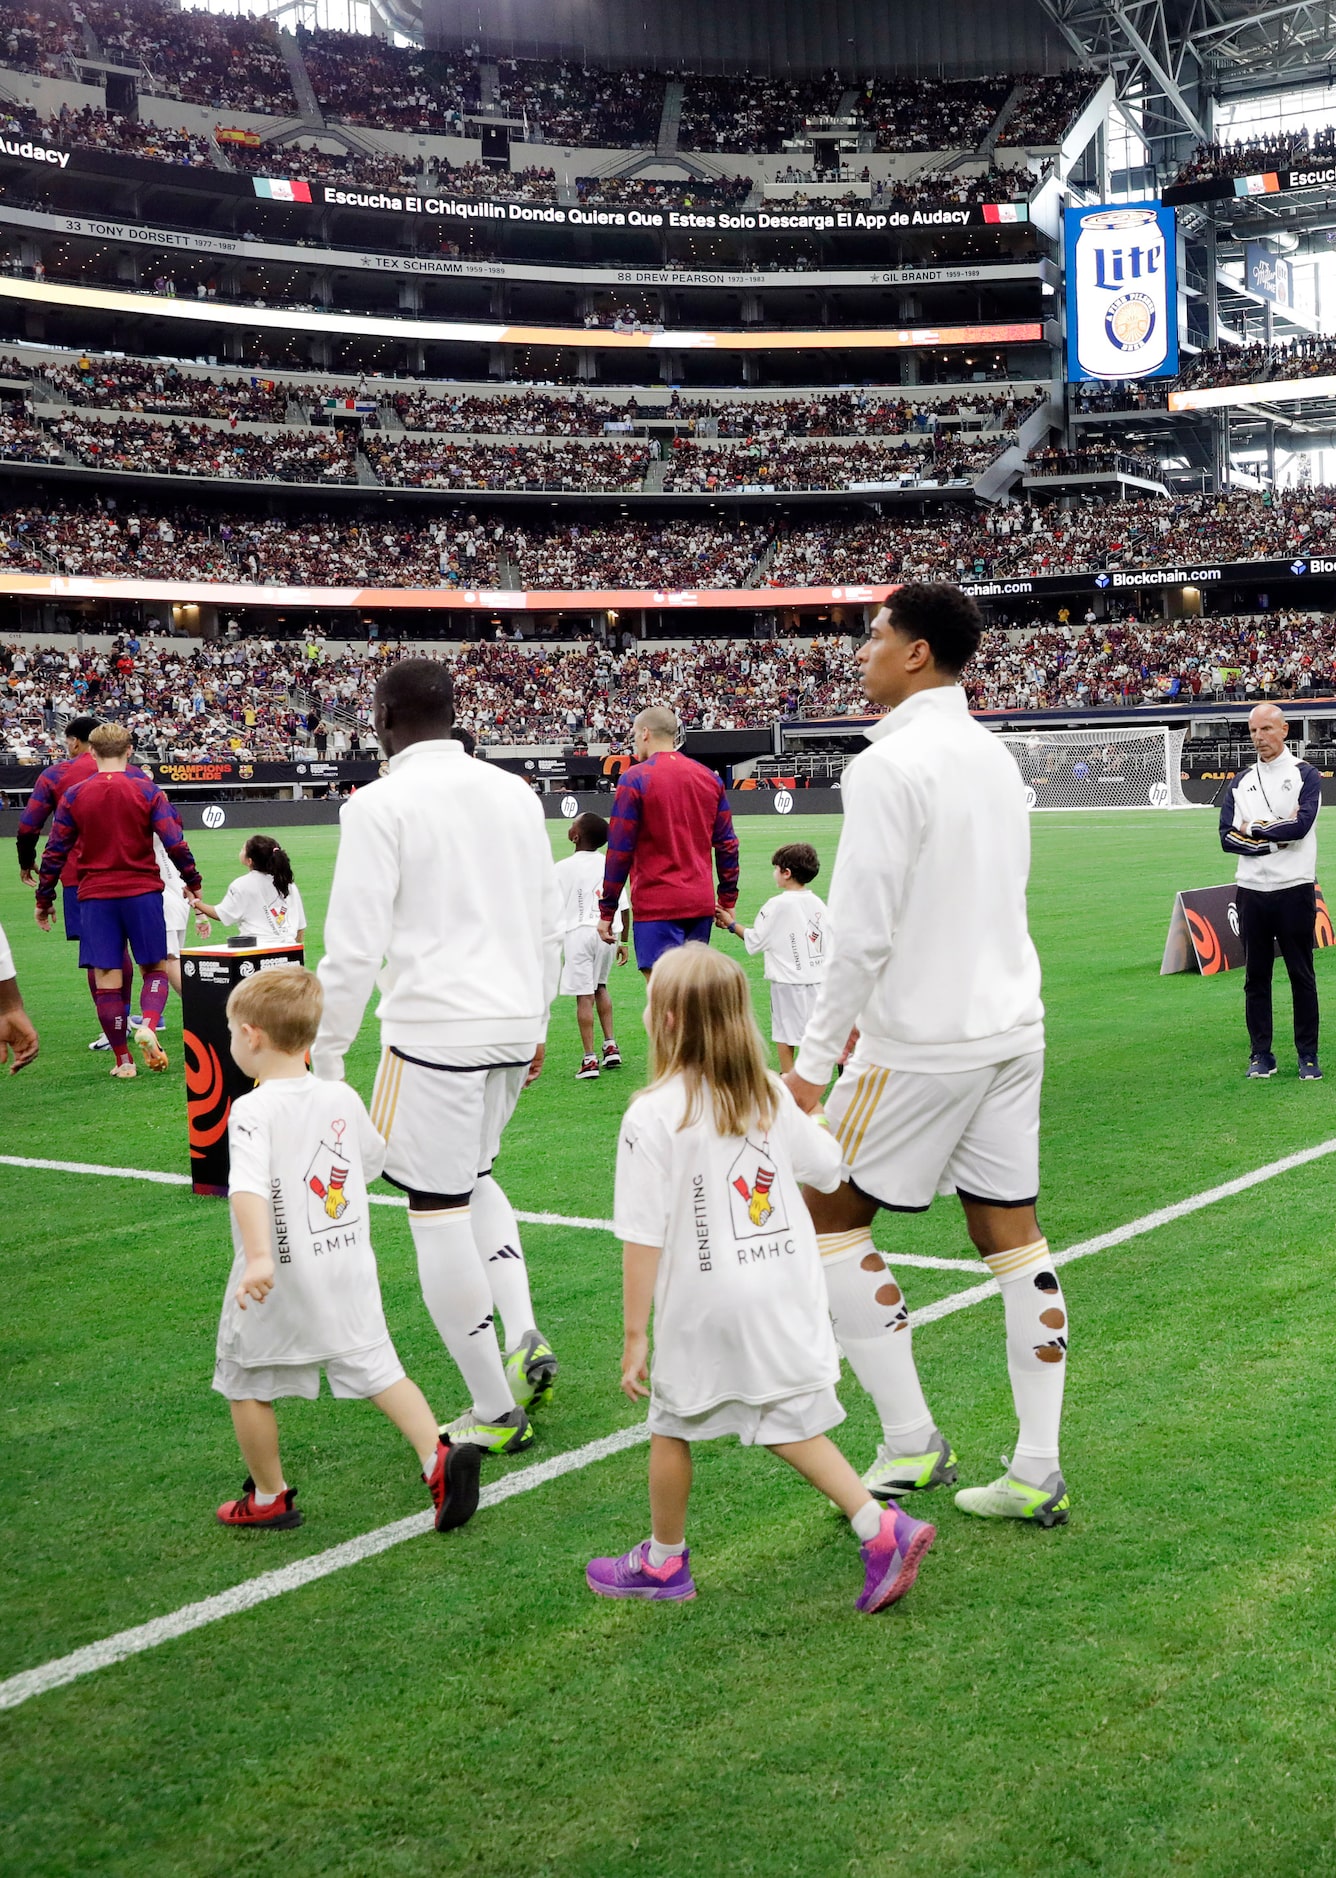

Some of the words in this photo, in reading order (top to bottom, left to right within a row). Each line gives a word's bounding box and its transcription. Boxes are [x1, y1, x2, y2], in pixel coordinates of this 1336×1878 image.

[0, 136, 70, 168] Audacy
[324, 188, 402, 211] Escucha
[406, 197, 422, 213] El
[425, 200, 505, 220] Chiquilin
[509, 204, 566, 224] Donde
[568, 209, 625, 227] Quiera
[628, 211, 663, 227] Que
[669, 213, 716, 228] Estes
[719, 213, 756, 229] Solo
[759, 213, 834, 230] Descarga
[838, 212, 852, 227] El
[855, 212, 889, 230] App
[891, 211, 909, 227] de
[912, 209, 971, 226] Audacy
[65, 220, 82, 231] 33
[89, 223, 123, 237] TONY
[129, 228, 191, 247] DORSETT
[375, 257, 399, 269] TEX
[403, 260, 463, 273] SCHRAMM
[882, 272, 899, 282] GIL
[901, 271, 942, 282] BRANDT
[1093, 245, 1161, 291] Lite
[617, 273, 631, 282] 88
[636, 273, 669, 283] DREW
[672, 274, 725, 283] PEARSON
[959, 582, 1032, 597] kchain.com
[1113, 567, 1222, 588] Blockchain.com
[159, 764, 232, 774] CHAMPIONS
[171, 772, 222, 781] COLLIDE
[269, 1176, 292, 1264] BENEFITING
[693, 1173, 713, 1273] BENEFITING
[737, 1238, 797, 1266] RMHC
